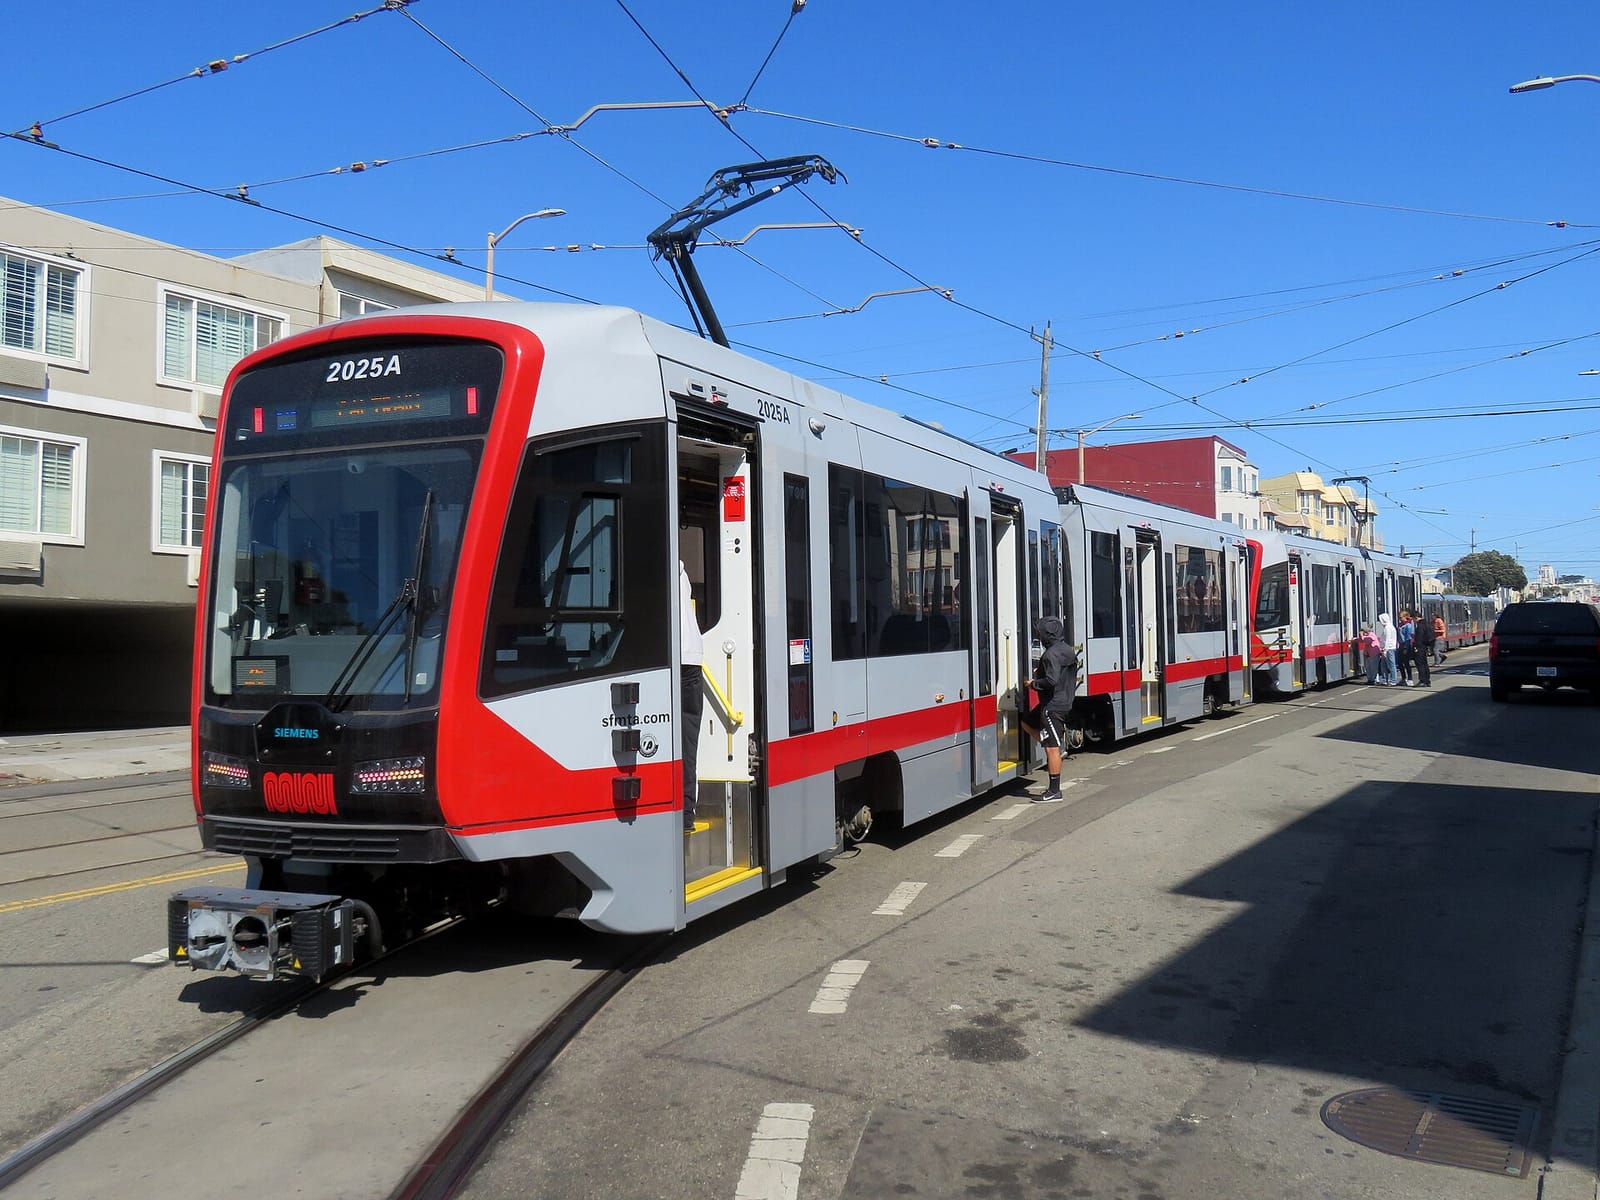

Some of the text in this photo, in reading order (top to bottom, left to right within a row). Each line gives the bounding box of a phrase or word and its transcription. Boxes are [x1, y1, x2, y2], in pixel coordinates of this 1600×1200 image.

[326, 354, 401, 383] 2025A
[757, 398, 791, 425] 2025A
[601, 712, 671, 728] sfmta.com
[274, 727, 320, 739] SIEMENS
